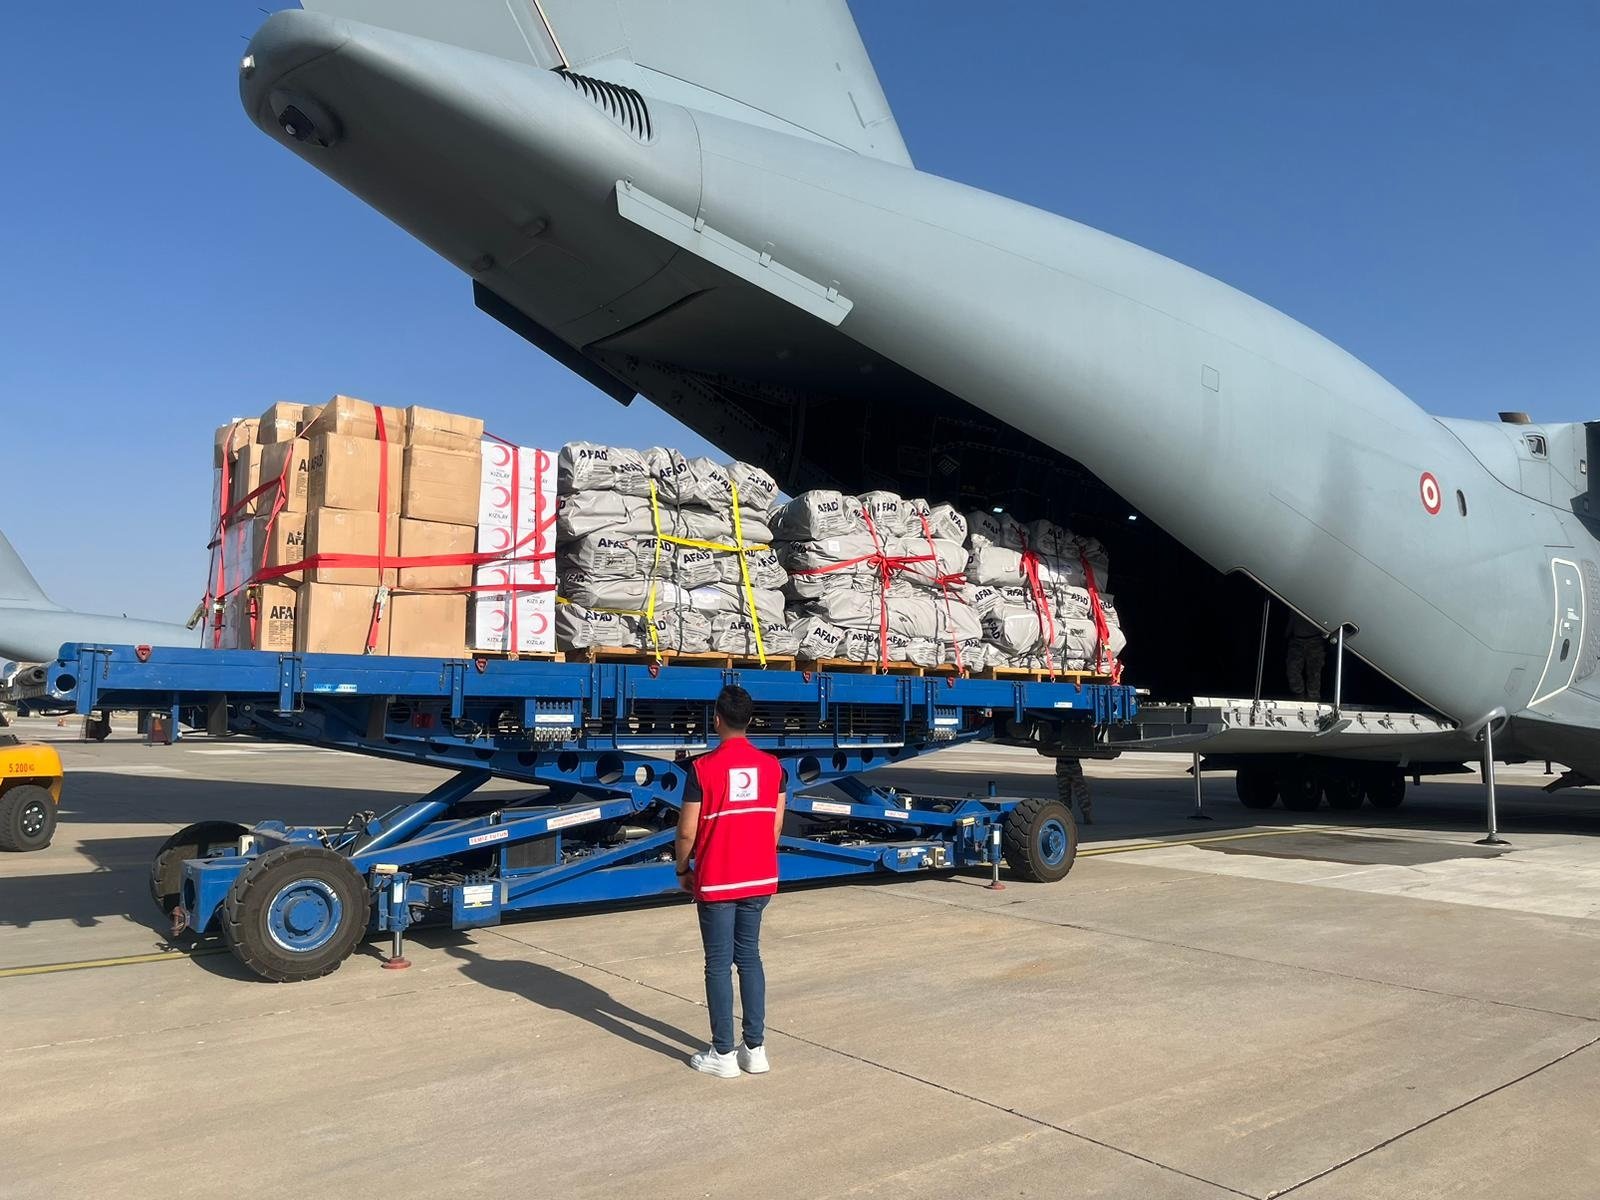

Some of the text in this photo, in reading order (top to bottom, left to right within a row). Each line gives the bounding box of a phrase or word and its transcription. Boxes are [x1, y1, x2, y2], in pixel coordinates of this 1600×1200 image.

[579, 449, 607, 460] AFAD
[748, 472, 774, 493] AFAD
[817, 501, 839, 514] AFAD
[853, 509, 865, 519] AFA
[949, 511, 964, 532] AFAD
[683, 552, 710, 564] AFAD
[768, 623, 790, 632] AFA
[813, 627, 838, 644] AFAD
